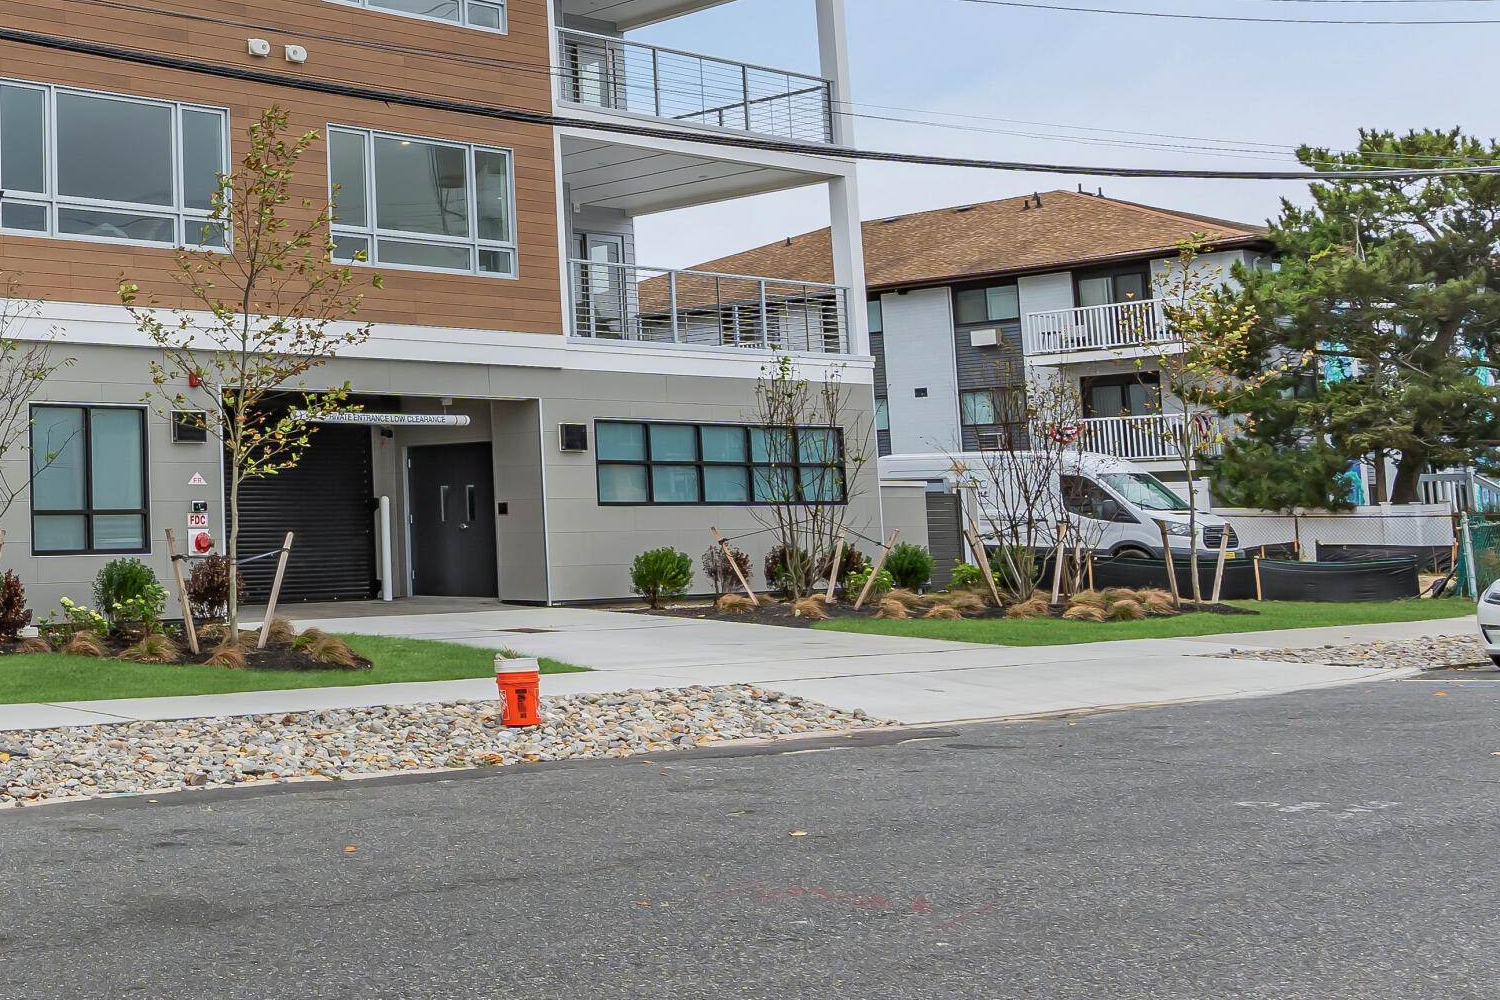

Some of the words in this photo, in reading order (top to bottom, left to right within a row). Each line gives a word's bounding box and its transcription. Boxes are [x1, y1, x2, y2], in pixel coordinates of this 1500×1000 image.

[325, 413, 352, 421] PRIVATE
[353, 414, 390, 423] ENTRANCE
[390, 415, 405, 423] LOW
[407, 415, 446, 424] CLEARANCE
[189, 515, 206, 525] FDC
